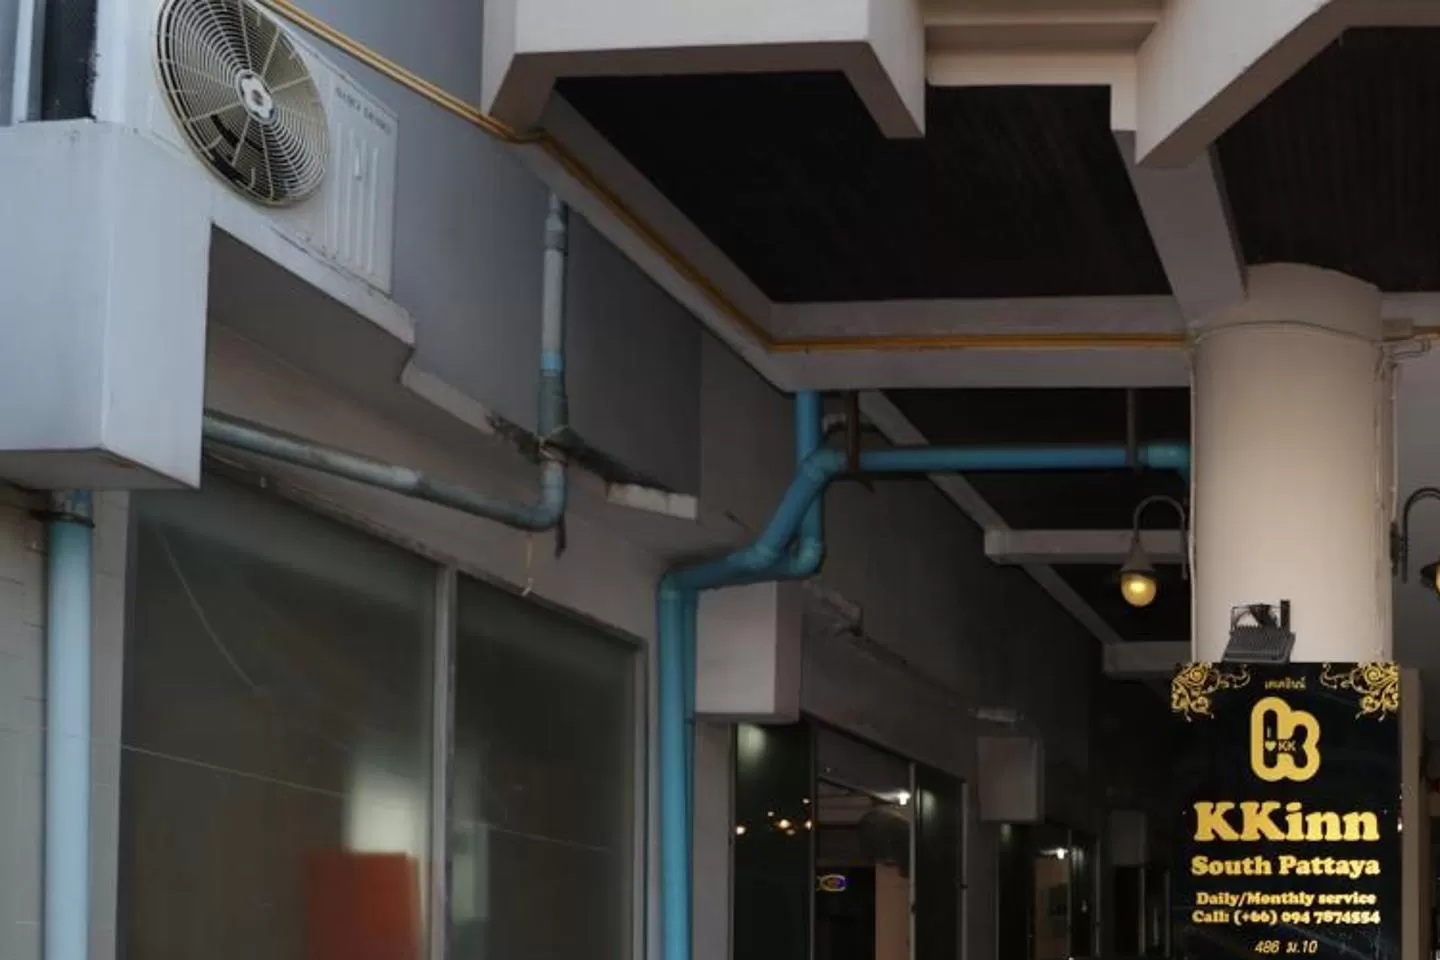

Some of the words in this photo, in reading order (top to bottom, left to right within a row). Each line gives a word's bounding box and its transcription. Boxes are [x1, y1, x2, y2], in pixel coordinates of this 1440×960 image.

[1193, 801, 1381, 842] KKinn
[1191, 856, 1273, 876] South
[1278, 856, 1381, 880] Pattaya
[1195, 891, 1315, 908] Daily/Monthly
[1318, 892, 1378, 906] service
[1192, 910, 1230, 924] Call:
[1254, 940, 1281, 953] 486
